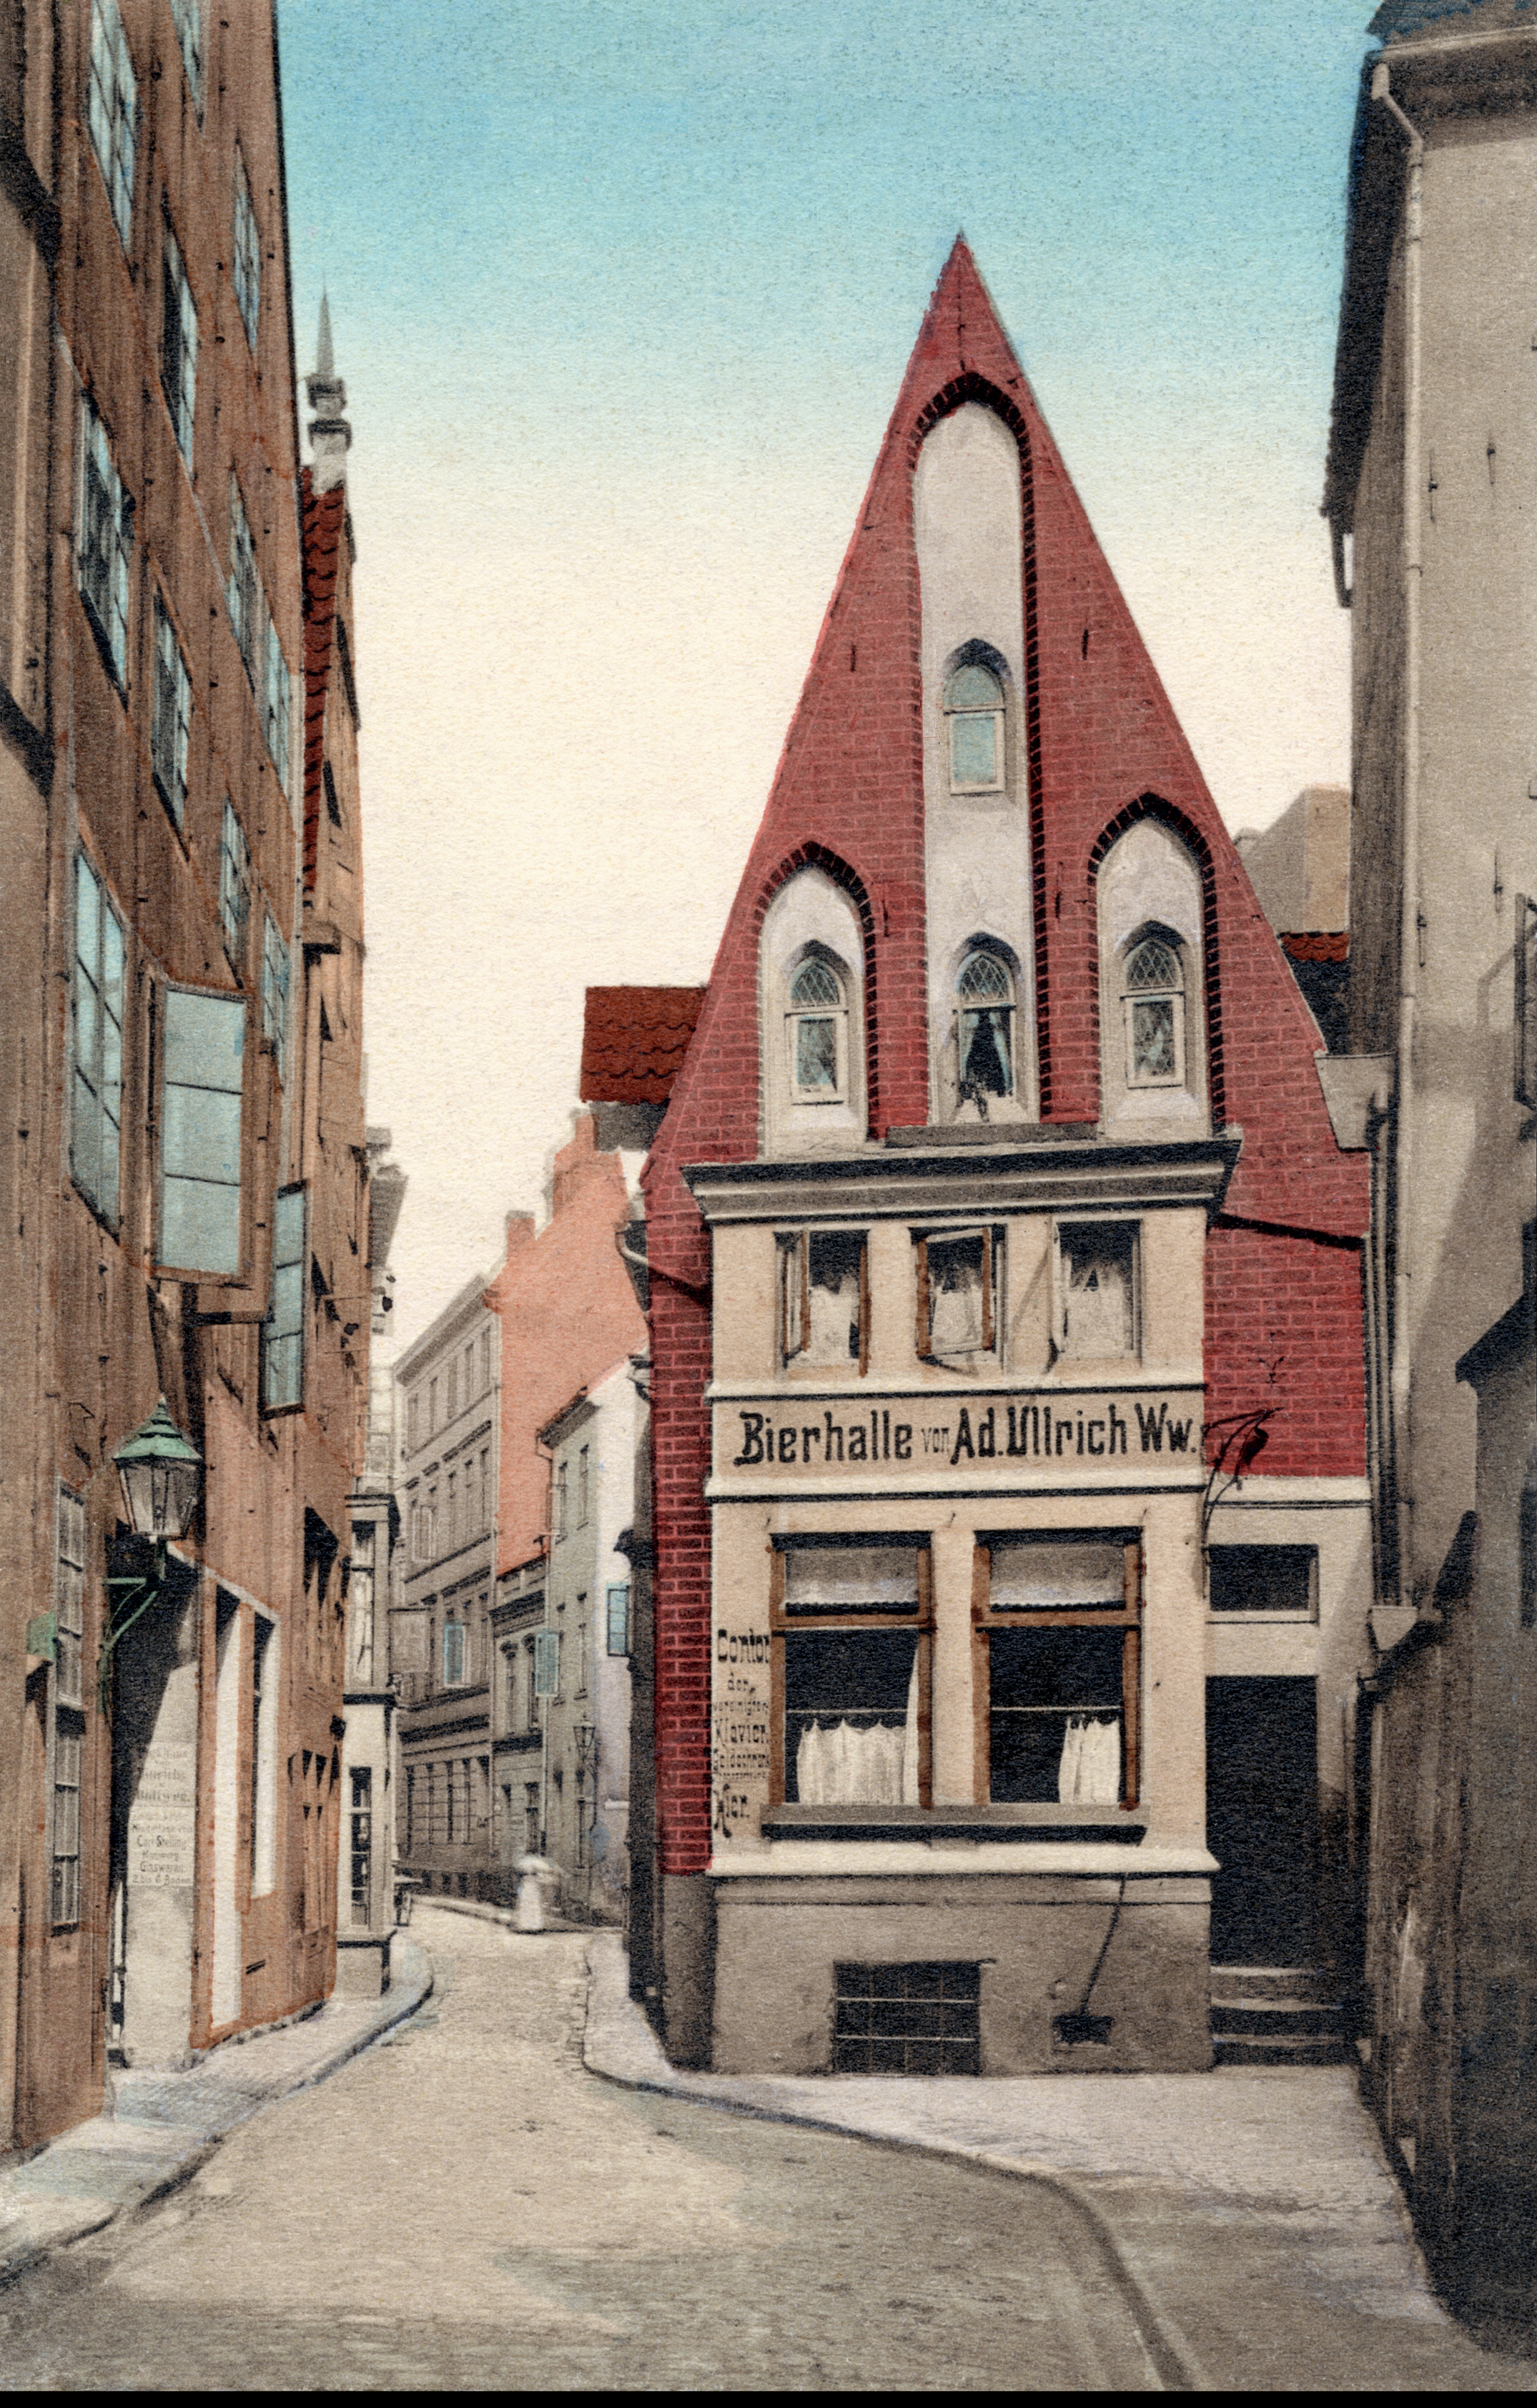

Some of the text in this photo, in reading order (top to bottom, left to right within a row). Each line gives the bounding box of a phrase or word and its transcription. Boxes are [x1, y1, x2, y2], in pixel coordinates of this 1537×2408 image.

[733, 1402, 1197, 1466] Bierhalle von Ad. Ullrich Ww.
[717, 1629, 769, 1663] Contor
